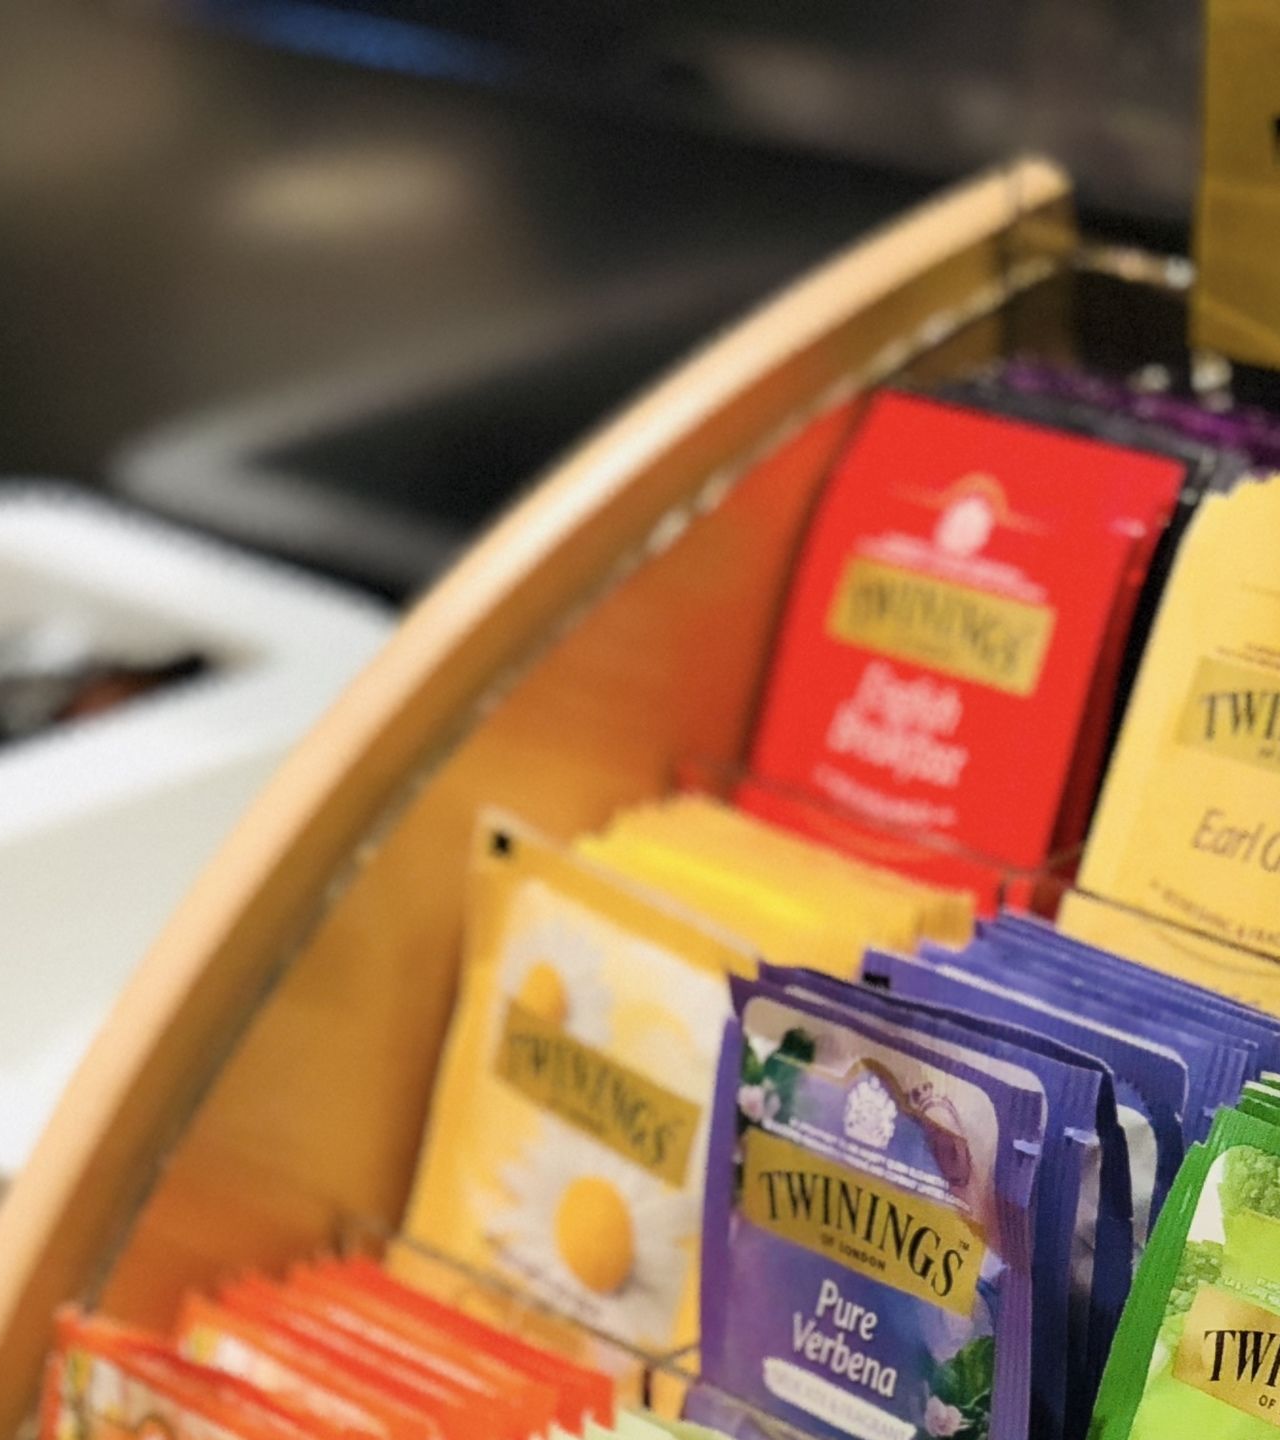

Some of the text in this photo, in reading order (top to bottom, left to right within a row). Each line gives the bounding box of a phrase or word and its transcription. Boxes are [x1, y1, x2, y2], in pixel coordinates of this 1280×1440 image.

[1192, 808, 1263, 864] Earl
[760, 1170, 963, 1298] TWININGS
[839, 1243, 886, 1272] LONDON
[815, 1278, 877, 1340] Pure
[792, 1311, 897, 1398] Verbena
[1258, 1393, 1276, 1411] OF
